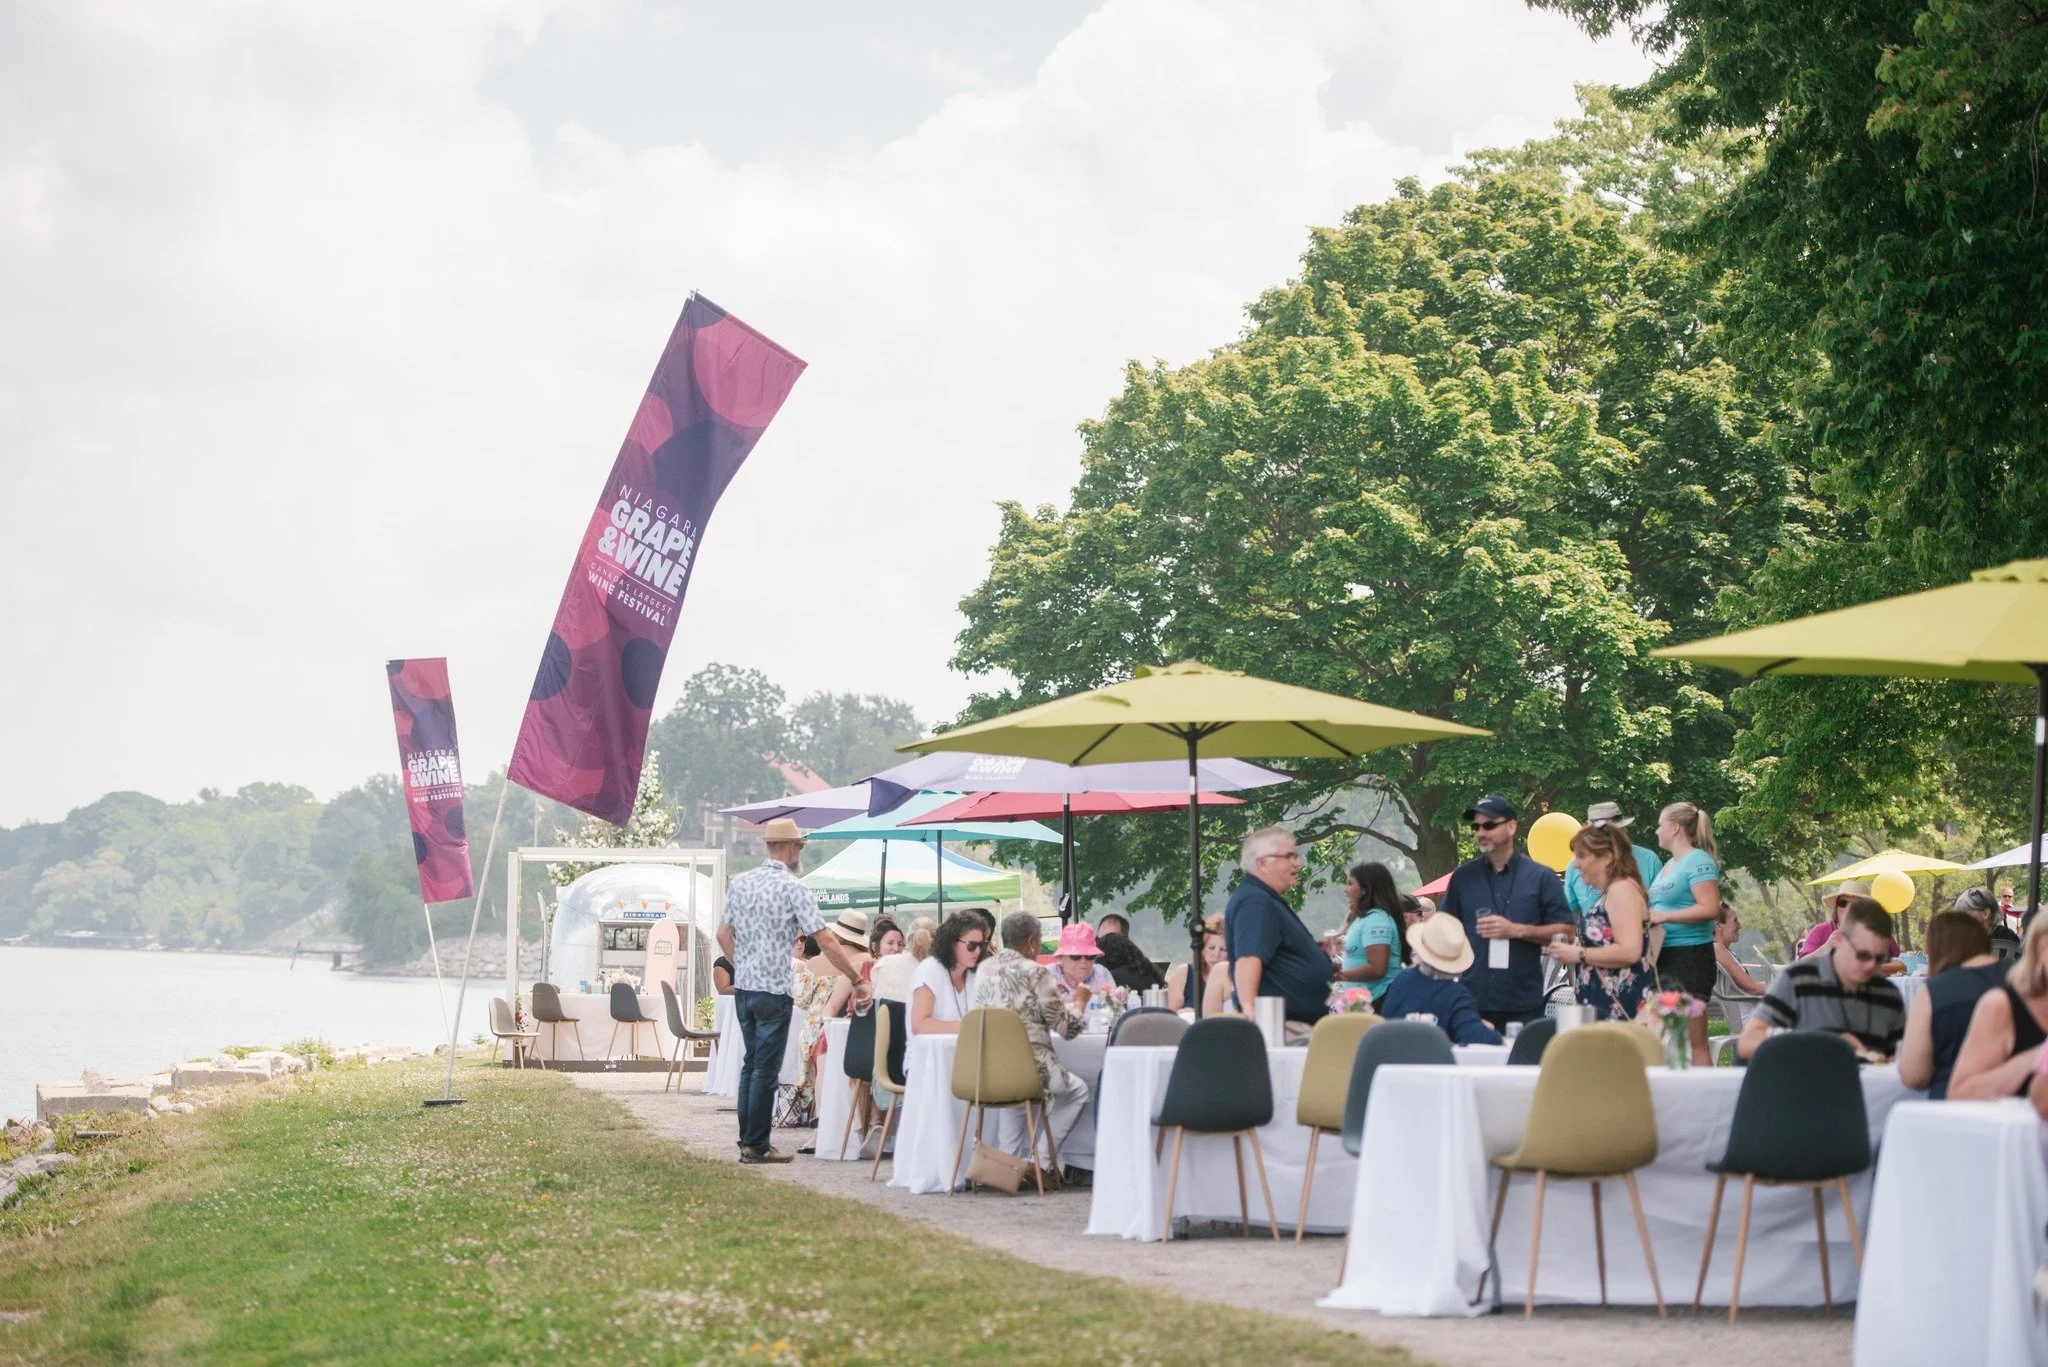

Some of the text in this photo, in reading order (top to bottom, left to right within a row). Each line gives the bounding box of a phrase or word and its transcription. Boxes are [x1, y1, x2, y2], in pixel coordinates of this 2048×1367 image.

[610, 499, 694, 569] GRAPE
[619, 484, 697, 541] NIAGARA
[597, 525, 687, 598] &WINE
[588, 570, 666, 627] WINE FESTIVAL
[590, 562, 673, 614] CANADA'S LARGEST
[407, 749, 454, 760] NIAGARA
[407, 756, 457, 774] GRAPE
[410, 769, 460, 788] &WINE
[413, 791, 462, 803] WINE FESTIVAL
